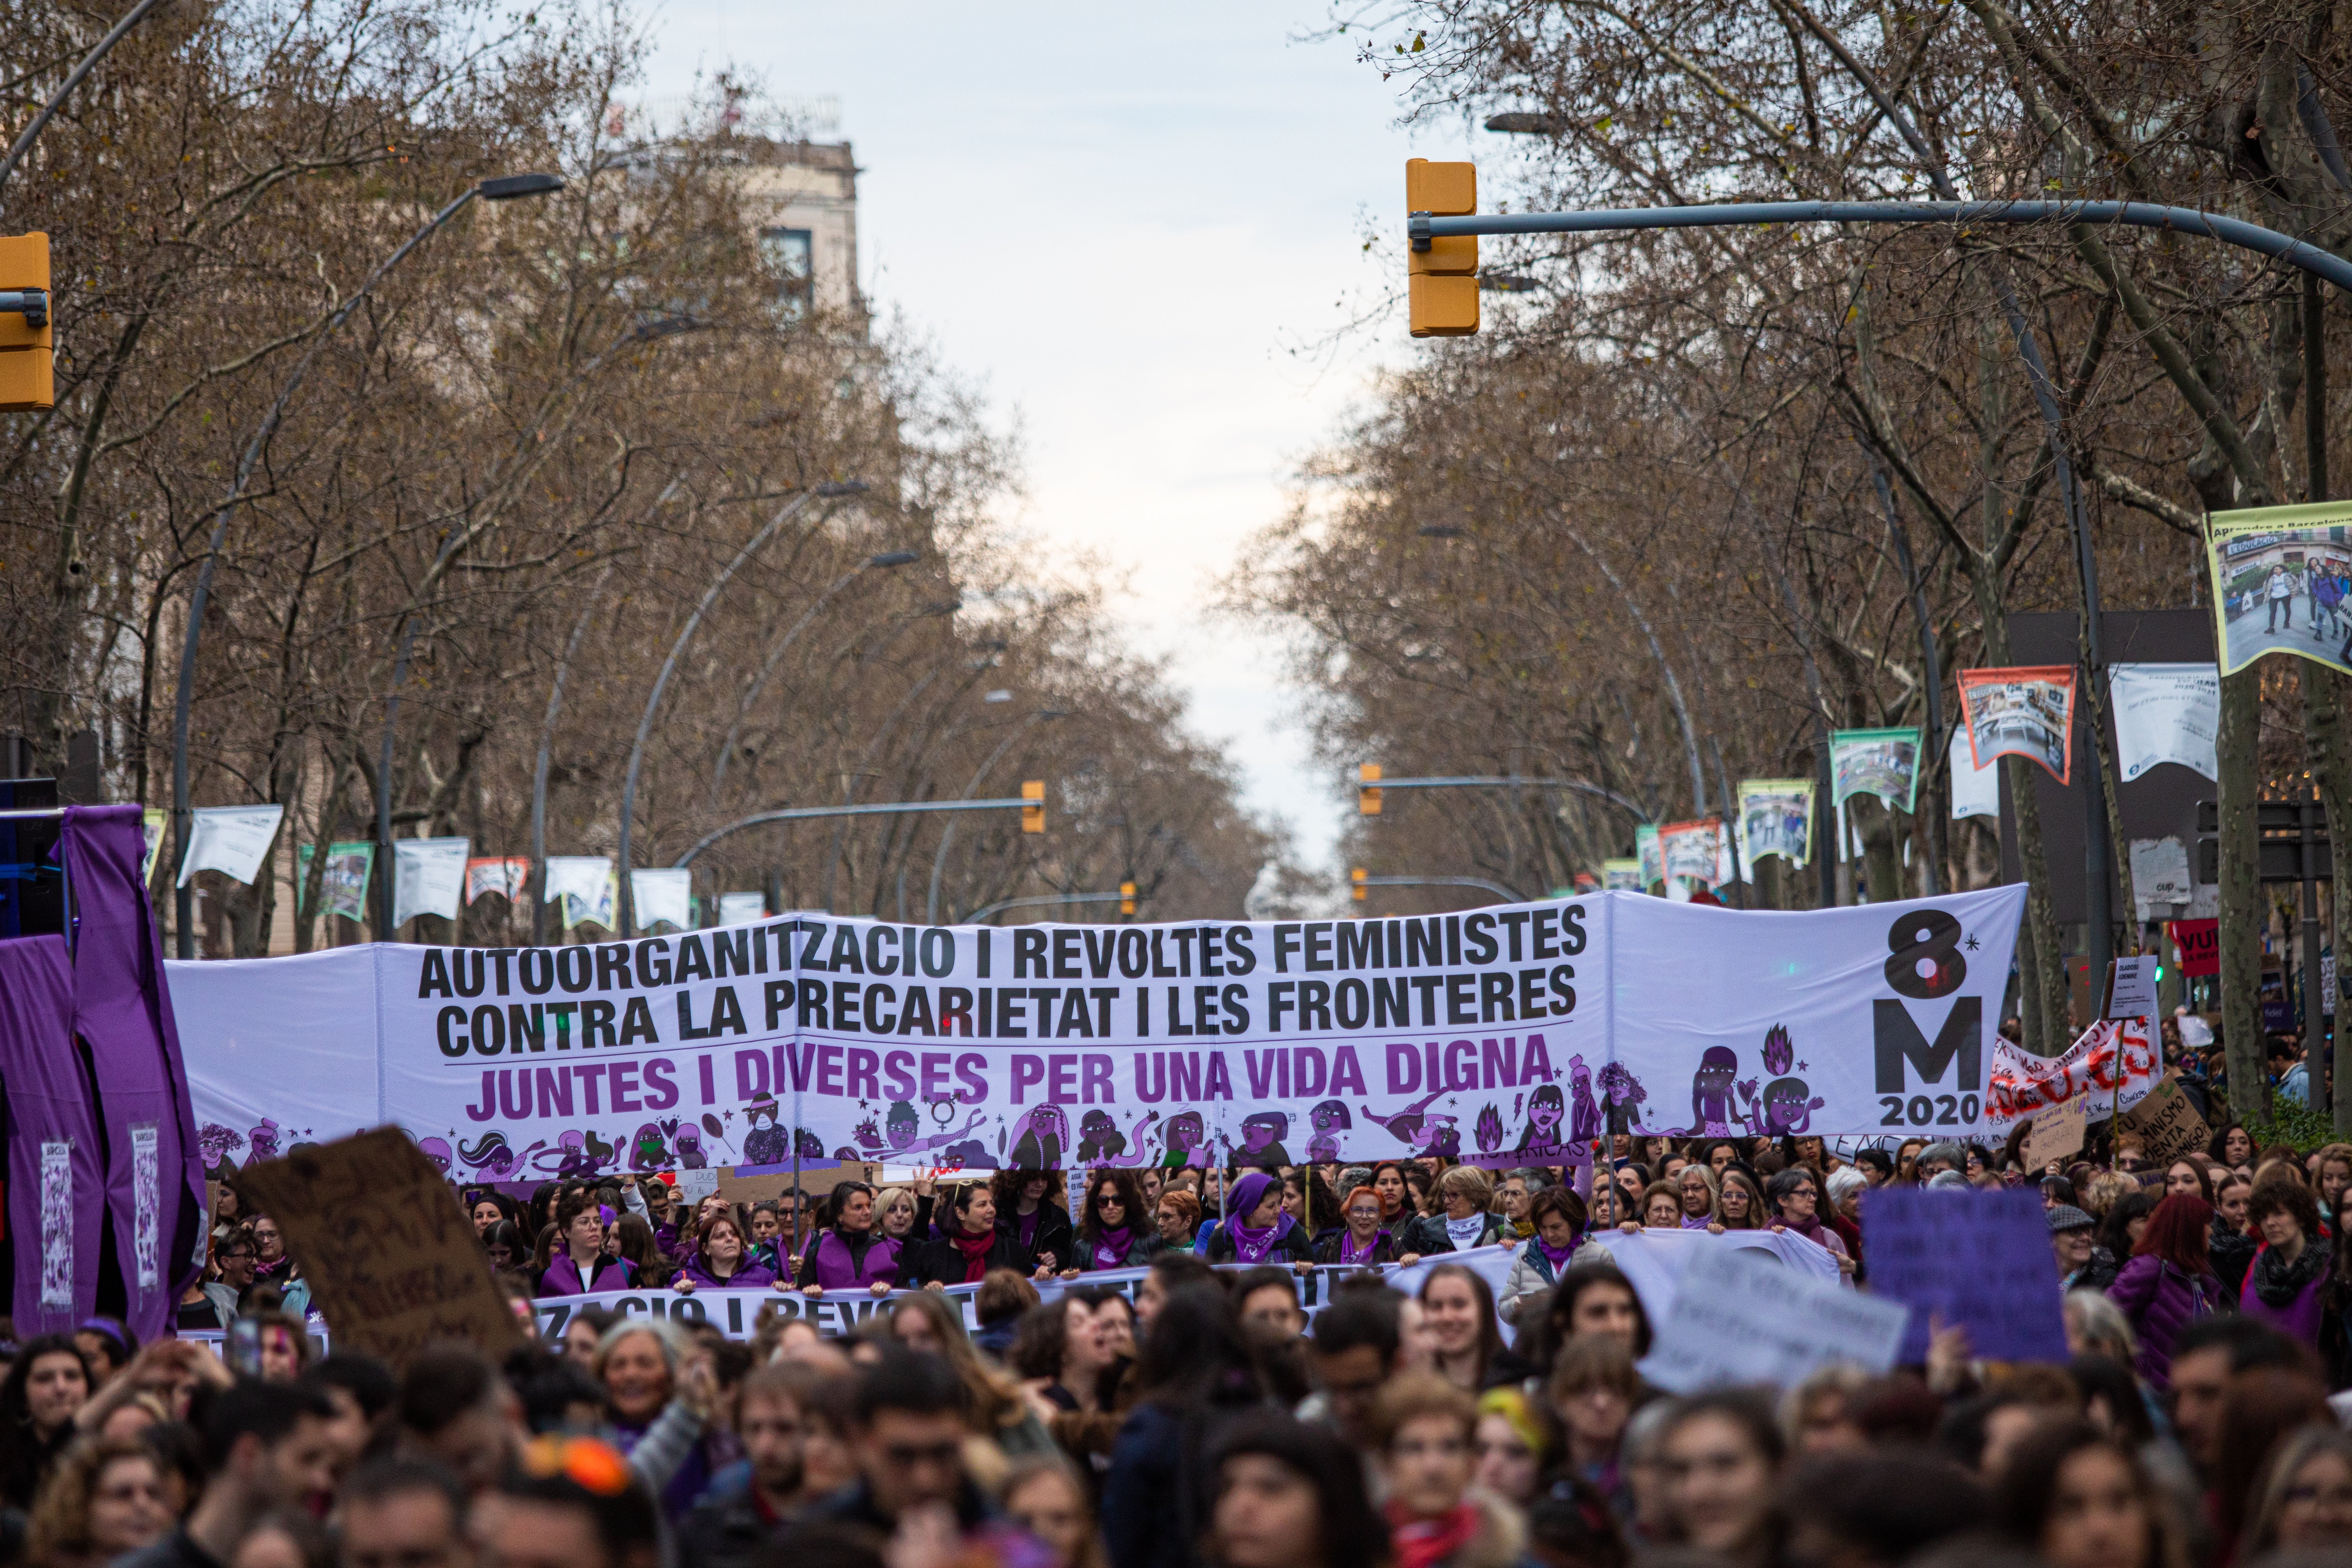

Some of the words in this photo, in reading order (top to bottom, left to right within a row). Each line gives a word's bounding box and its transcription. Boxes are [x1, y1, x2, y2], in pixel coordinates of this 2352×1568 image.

[2214, 525, 2273, 538] Aprendre
[977, 928, 990, 978] I
[1014, 925, 1256, 979] REVOLTES
[1273, 904, 1586, 974] FEMINISTES
[1884, 909, 1967, 999] 8
[436, 997, 659, 1057] CONTRA
[676, 986, 747, 1041] LA
[764, 979, 1119, 1038] PRECARIETAT
[1136, 987, 1149, 1037] I
[1167, 984, 1250, 1036] LES
[1268, 964, 1576, 1032] FRONTERES
[1873, 996, 1981, 1094] M
[466, 1058, 679, 1122] JUNTES
[698, 1055, 716, 1105] I
[734, 1043, 988, 1105] DIVERSES
[1010, 1054, 1116, 1105] PER
[1134, 1051, 1233, 1102] UNA
[1244, 1045, 1367, 1099] VIDA
[1385, 1033, 1554, 1095] DIGNA
[1879, 1093, 1979, 1126] 2020
[2138, 1095, 2185, 1140] MINISMO
[1455, 1226, 1481, 1236] FEMINISTA
[727, 1298, 743, 1333] I
